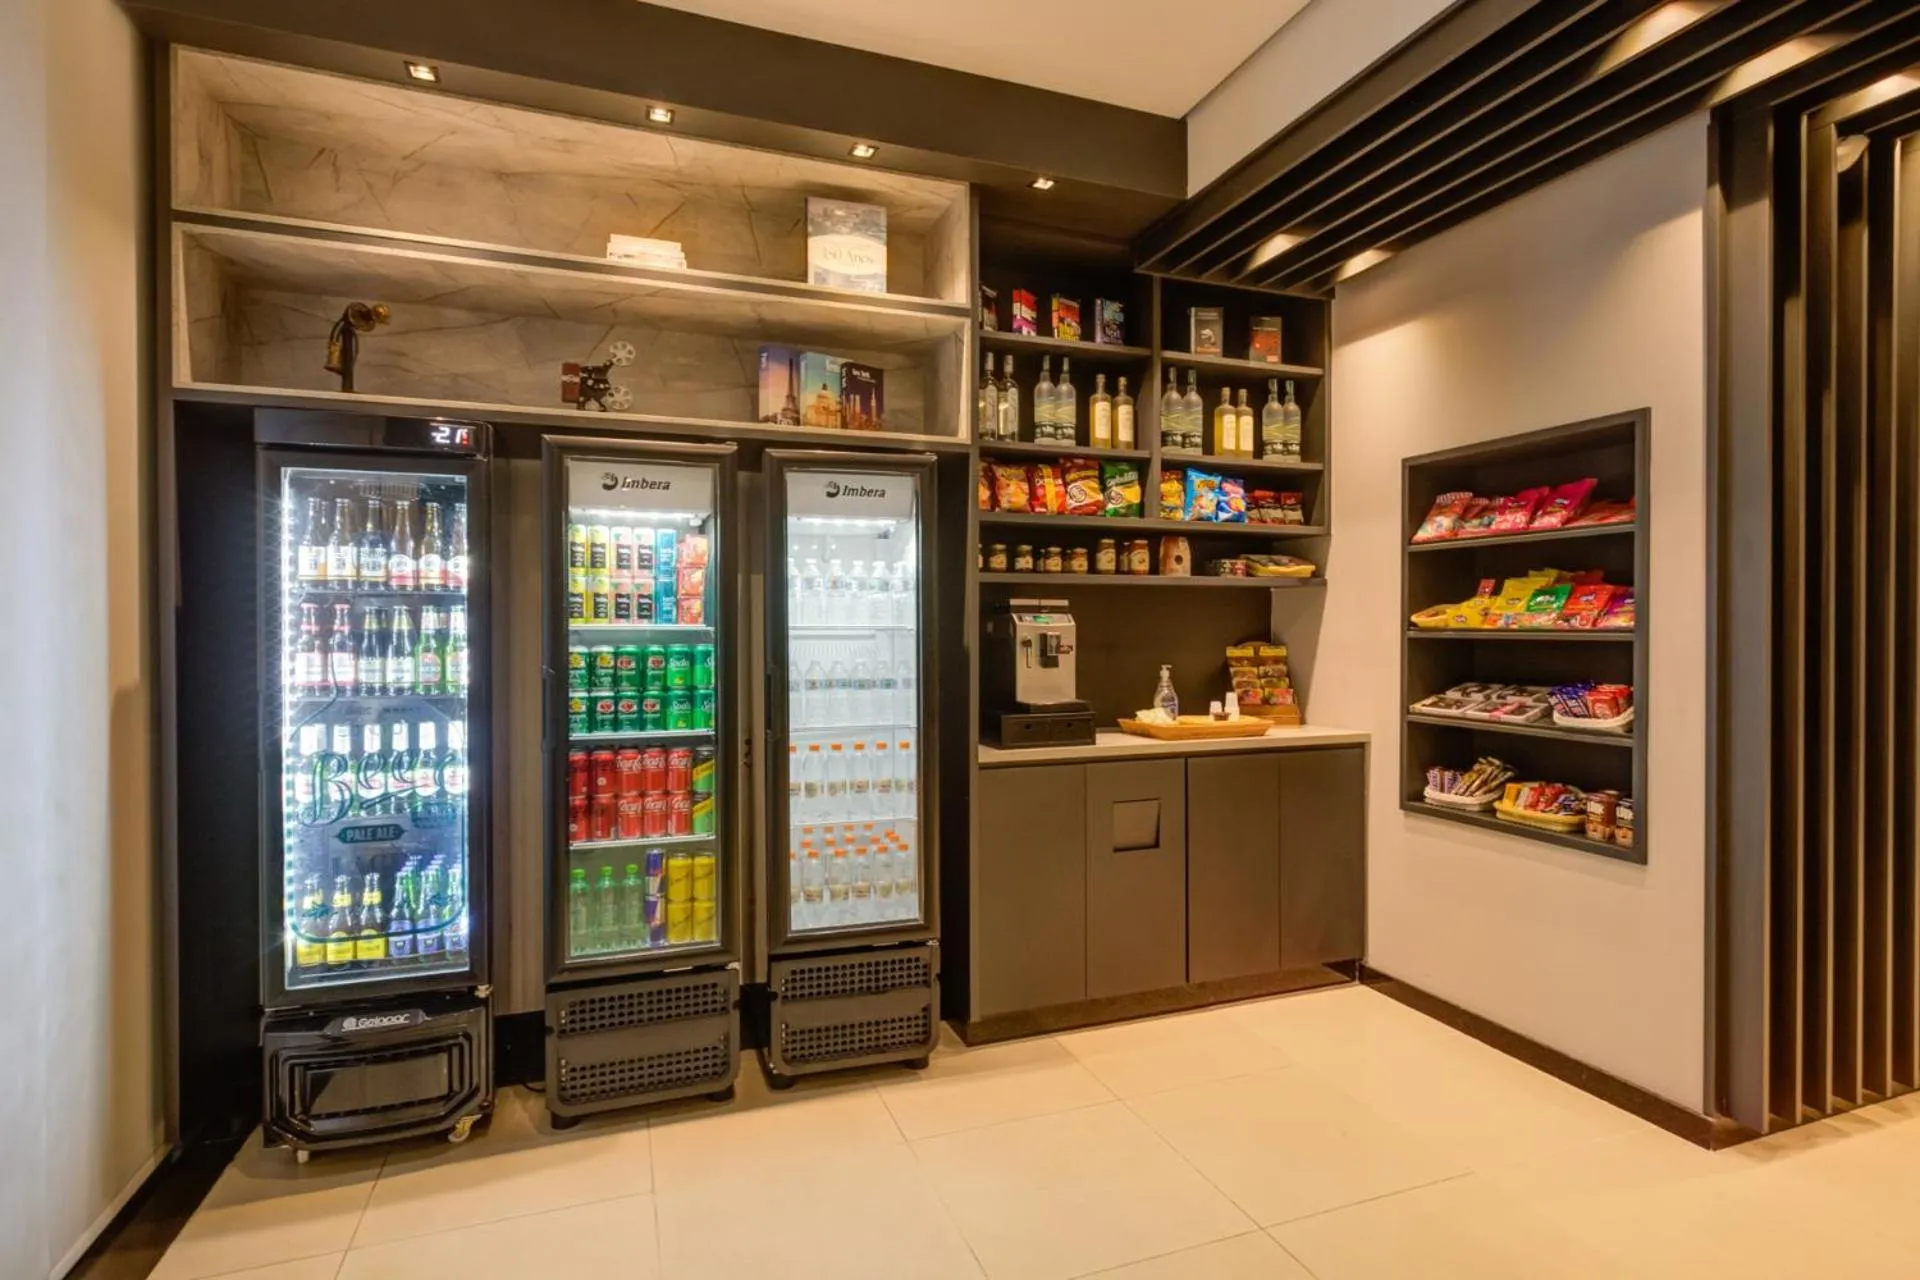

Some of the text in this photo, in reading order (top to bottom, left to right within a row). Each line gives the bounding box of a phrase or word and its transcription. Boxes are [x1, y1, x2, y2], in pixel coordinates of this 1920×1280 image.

[621, 476, 672, 491] Imbera
[842, 484, 886, 498] Imbera
[297, 750, 456, 828] Beer
[346, 826, 397, 841] PALE ALE
